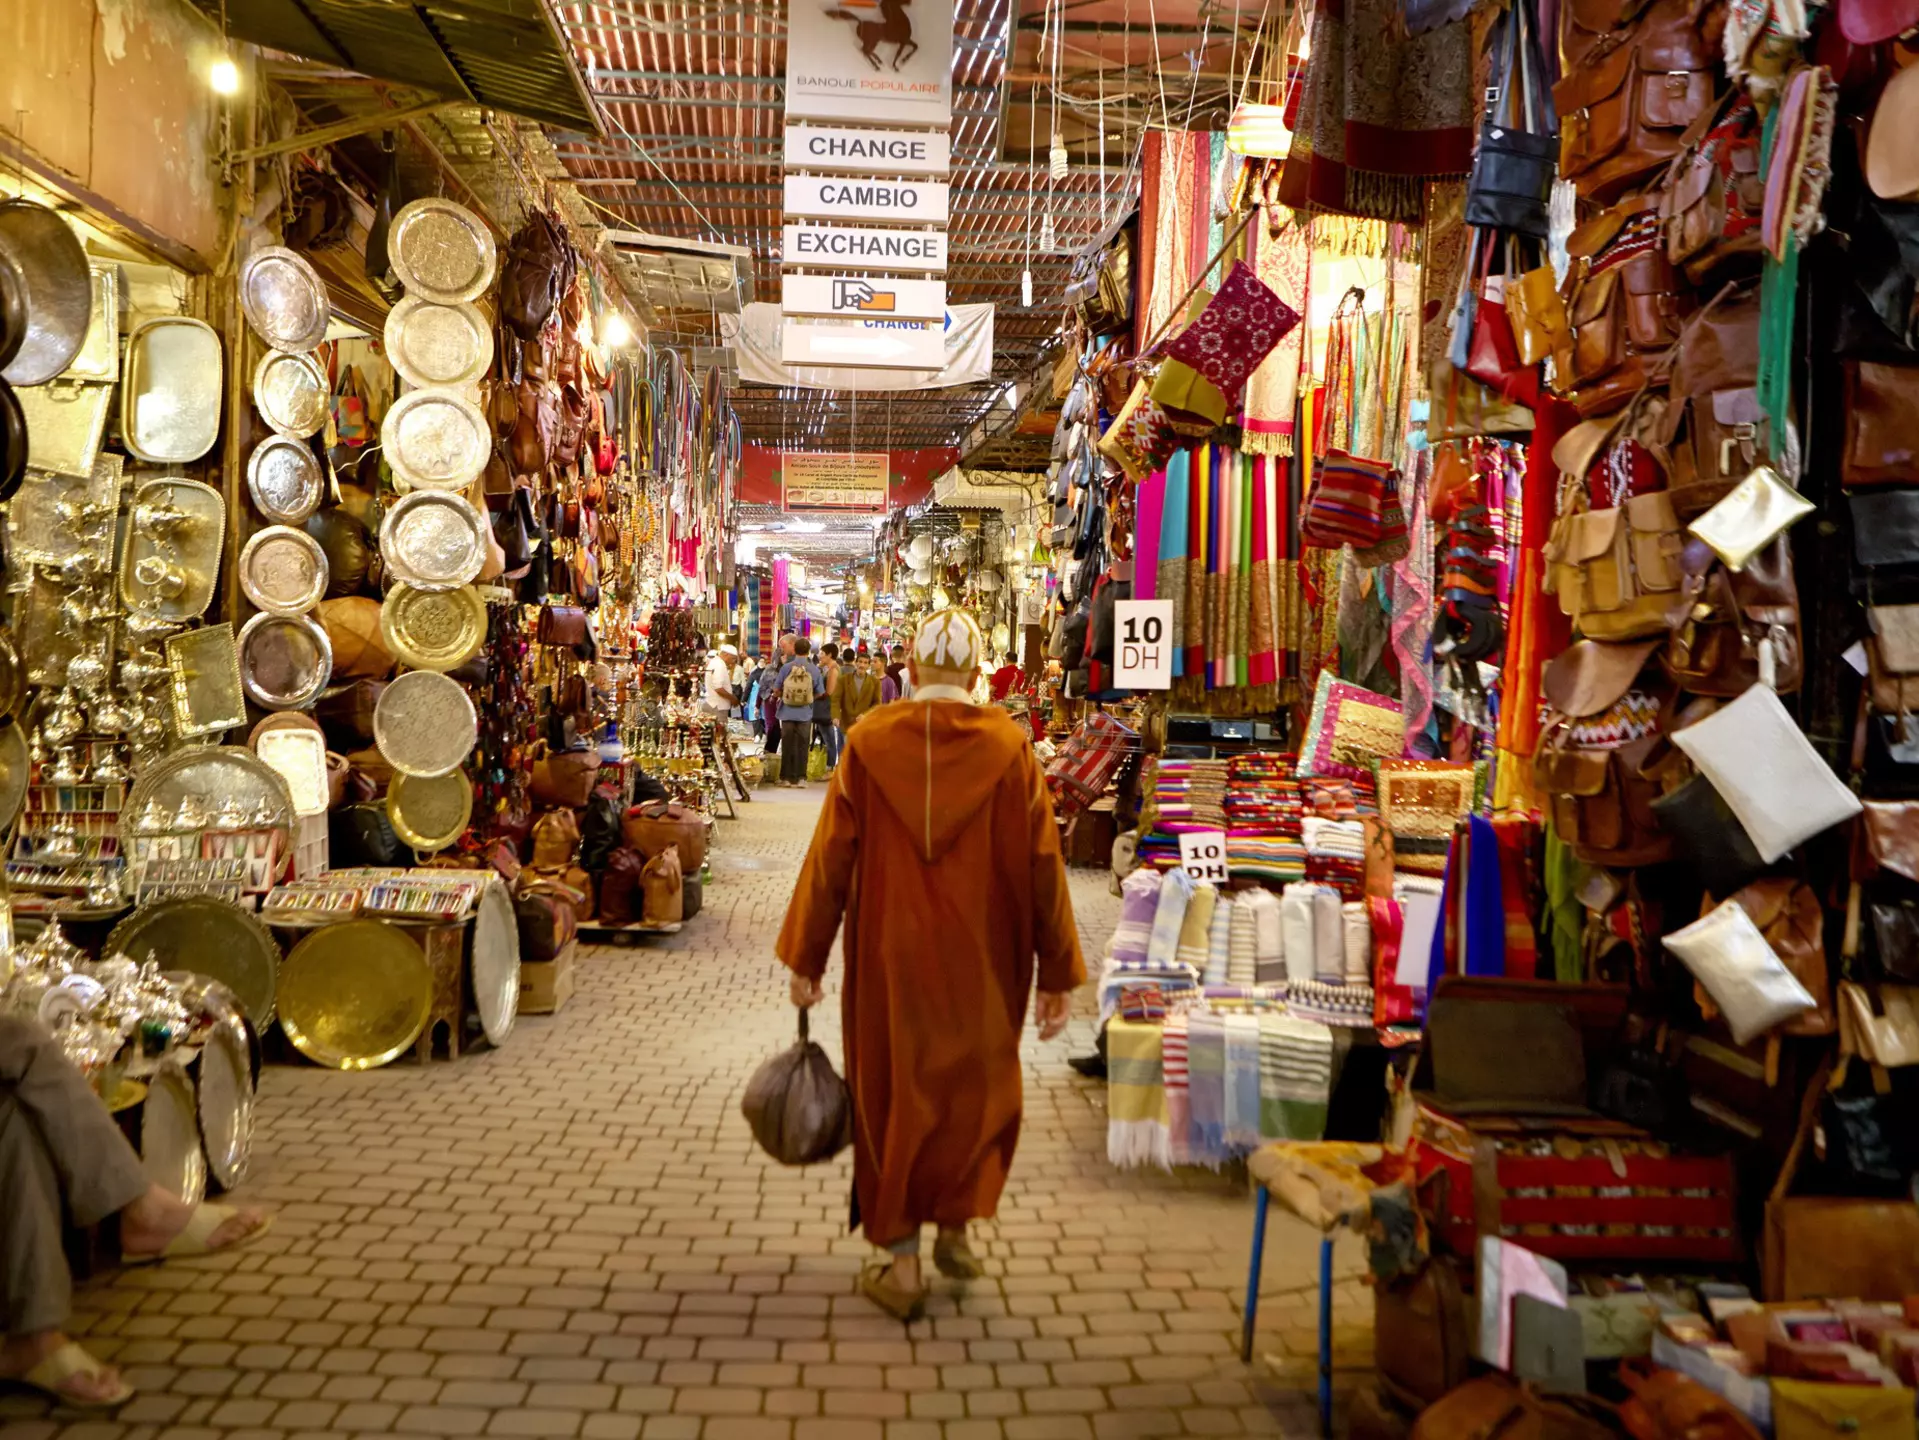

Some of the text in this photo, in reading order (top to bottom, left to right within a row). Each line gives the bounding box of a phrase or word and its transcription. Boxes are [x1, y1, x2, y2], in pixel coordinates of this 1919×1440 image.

[797, 75, 940, 93] BANQUE POPULAIRE
[808, 137, 926, 160] CHANGE
[819, 185, 918, 208] CAMBIO
[797, 232, 938, 258] EXCHANGE
[1123, 616, 1162, 644] 10
[1122, 646, 1159, 669] DH
[1189, 845, 1219, 860] 10
[1187, 864, 1224, 879] DH
